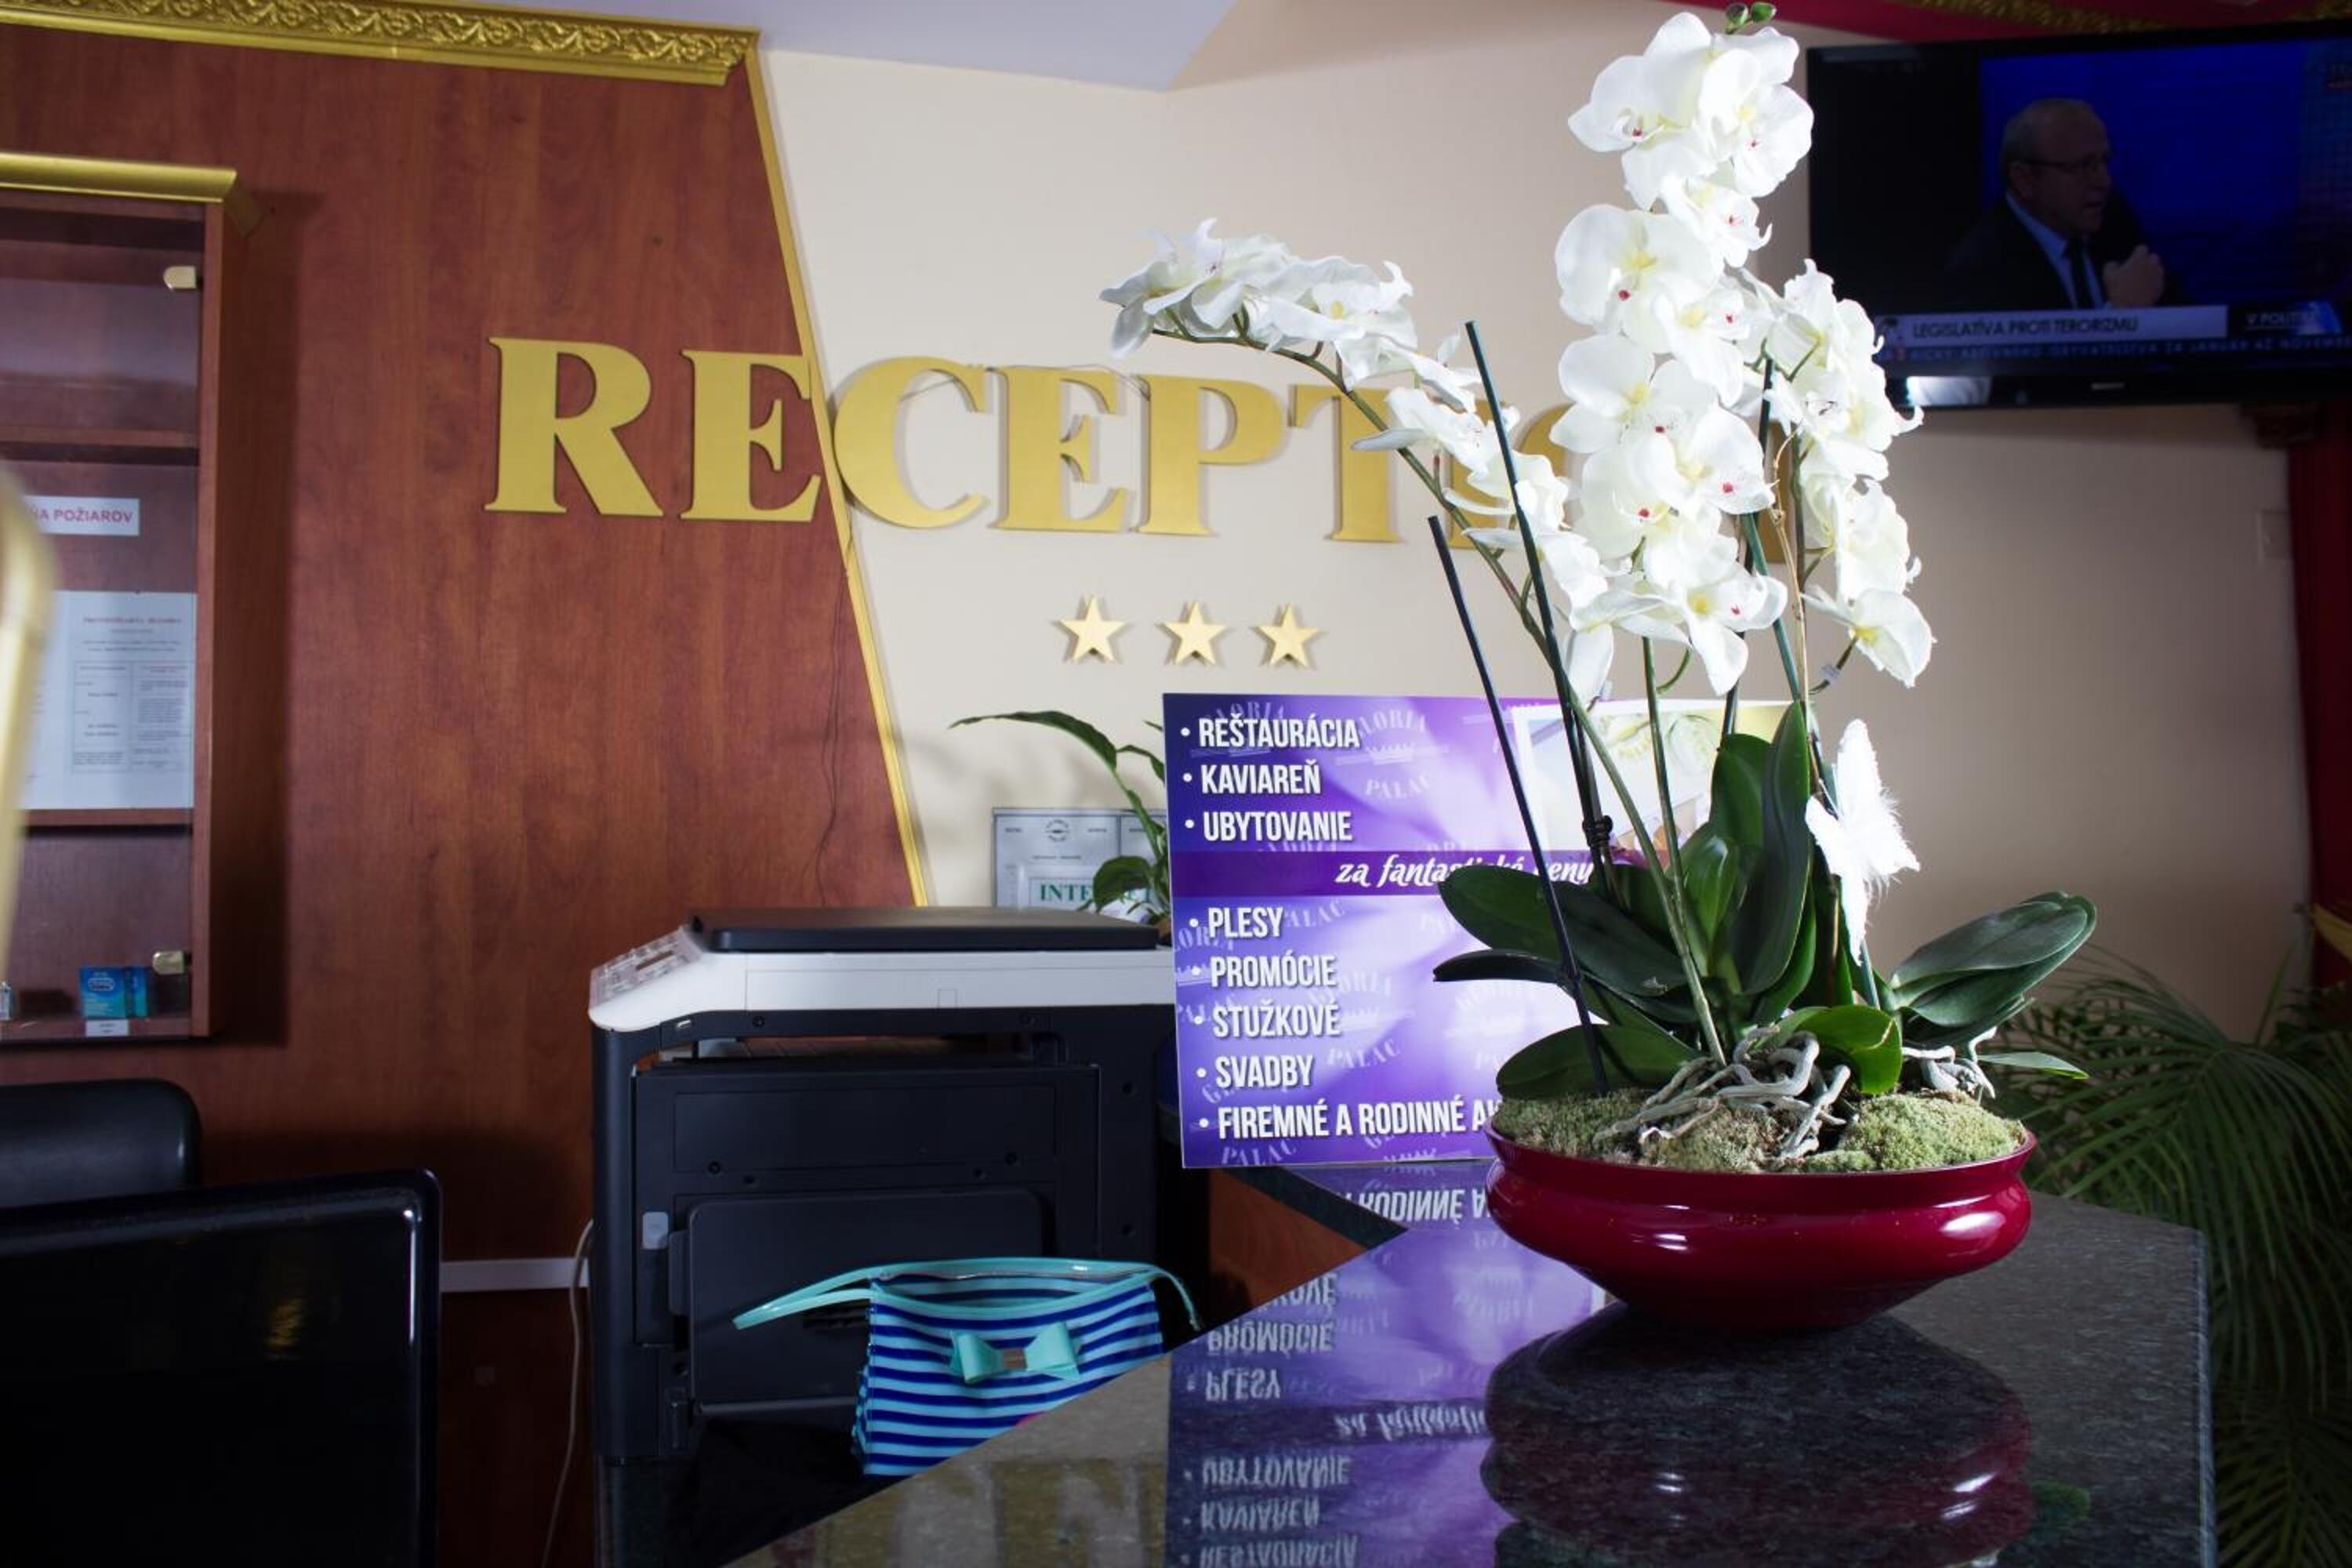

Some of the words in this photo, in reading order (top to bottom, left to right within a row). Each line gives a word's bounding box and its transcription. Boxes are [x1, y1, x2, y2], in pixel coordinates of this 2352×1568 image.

[2008, 318, 2051, 336] PROTI
[484, 335, 1795, 566] RECEPT
[53, 506, 134, 524] POŽIAROV
[1198, 712, 1361, 749] REŠTAURÁCIA
[1200, 759, 1322, 795] KAVIAREŇ
[1203, 810, 1353, 842] UBYTOVANIE
[1334, 863, 1371, 887] za
[1534, 861, 1594, 885] eny
[1207, 906, 1283, 938] PLESY
[1210, 949, 1337, 987] PROMÓCIE
[1213, 999, 1341, 1037] STUŽKOVÉ
[1215, 1054, 1314, 1088] SVADBY
[1218, 1098, 1330, 1139] FIREMNÉ
[1336, 1103, 1353, 1135] A
[1359, 1094, 1467, 1134] RODINNÉ
